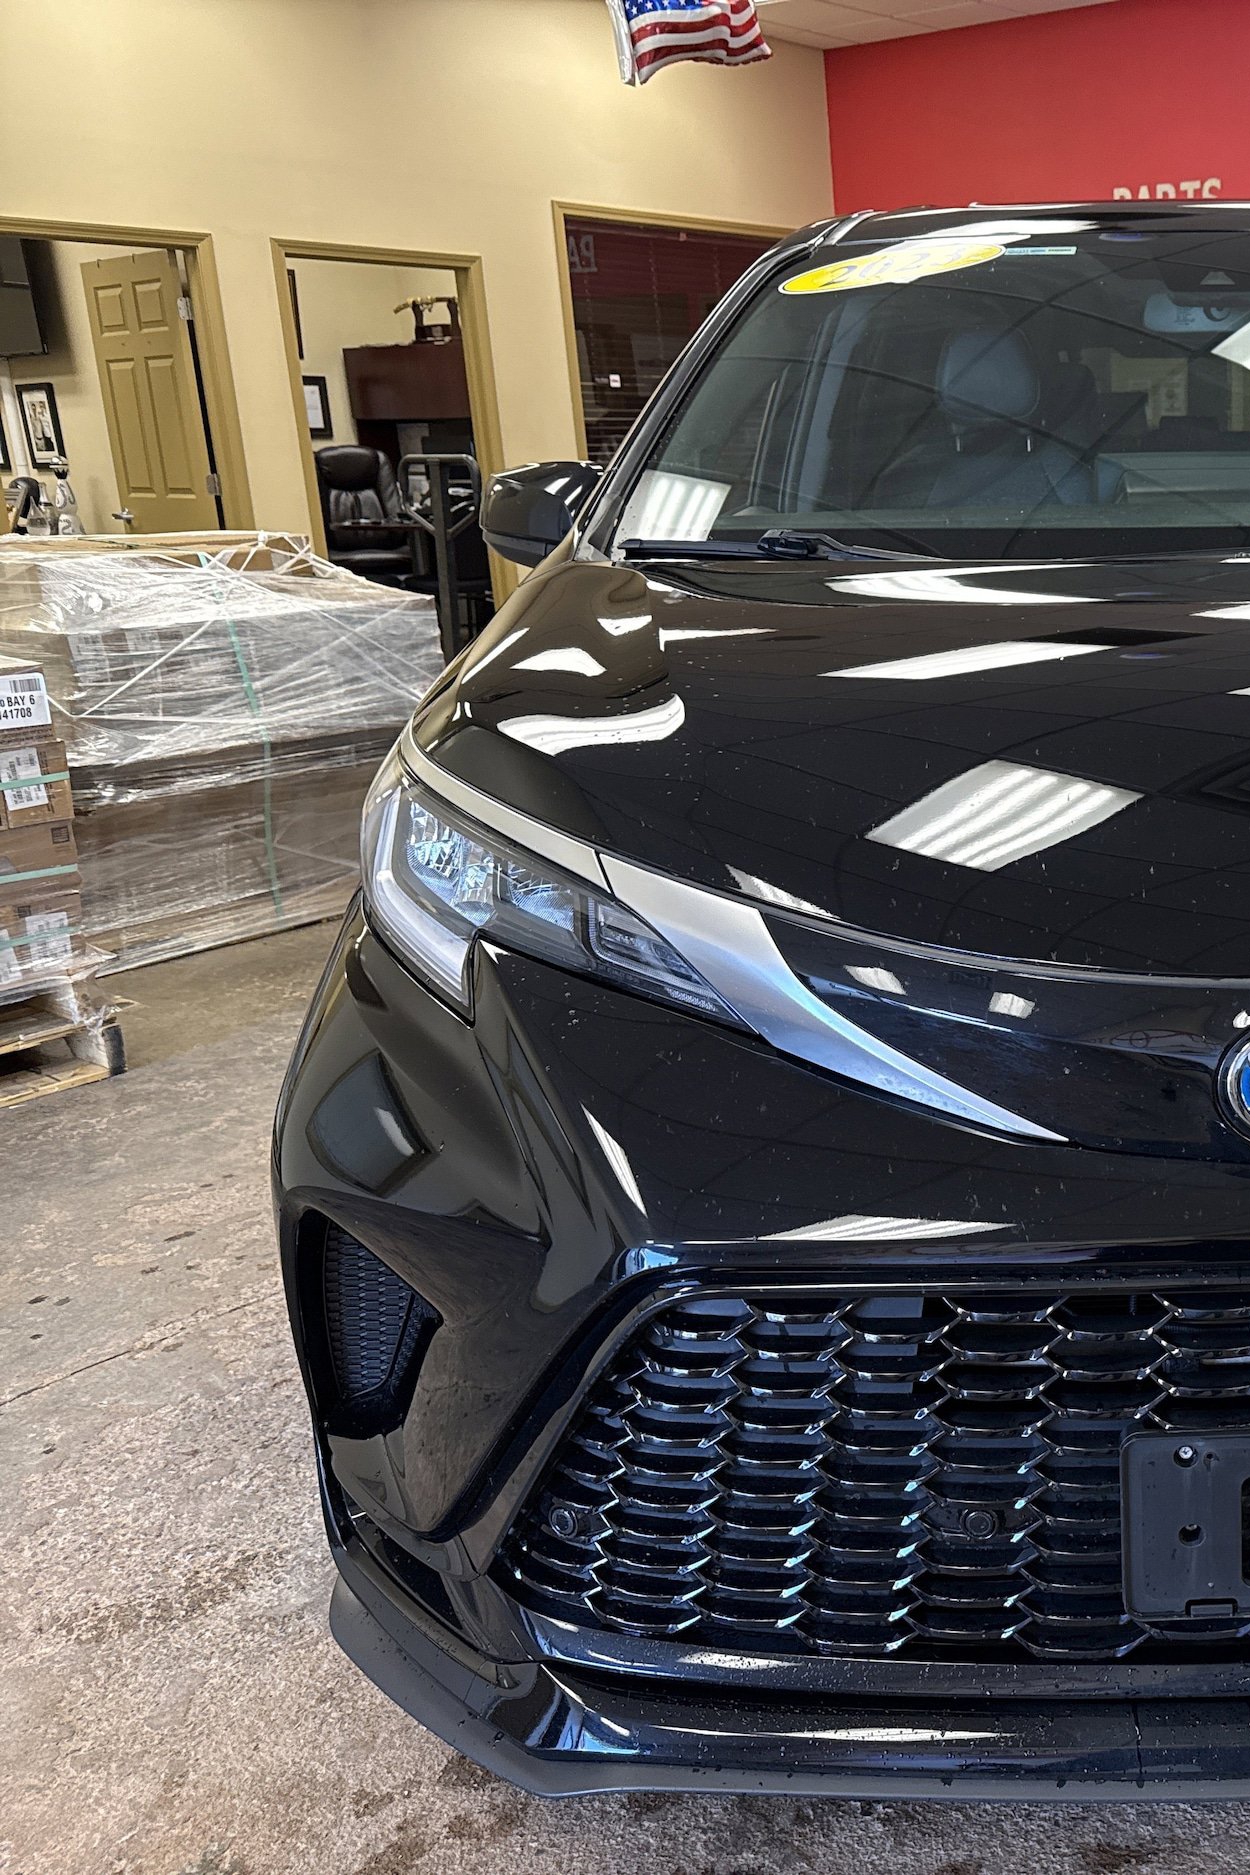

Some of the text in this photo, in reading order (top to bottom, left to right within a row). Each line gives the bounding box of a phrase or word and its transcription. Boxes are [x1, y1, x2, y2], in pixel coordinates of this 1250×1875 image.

[6, 695, 26, 708] BAY
[29, 694, 36, 705] 6
[0, 707, 32, 720] 41708
